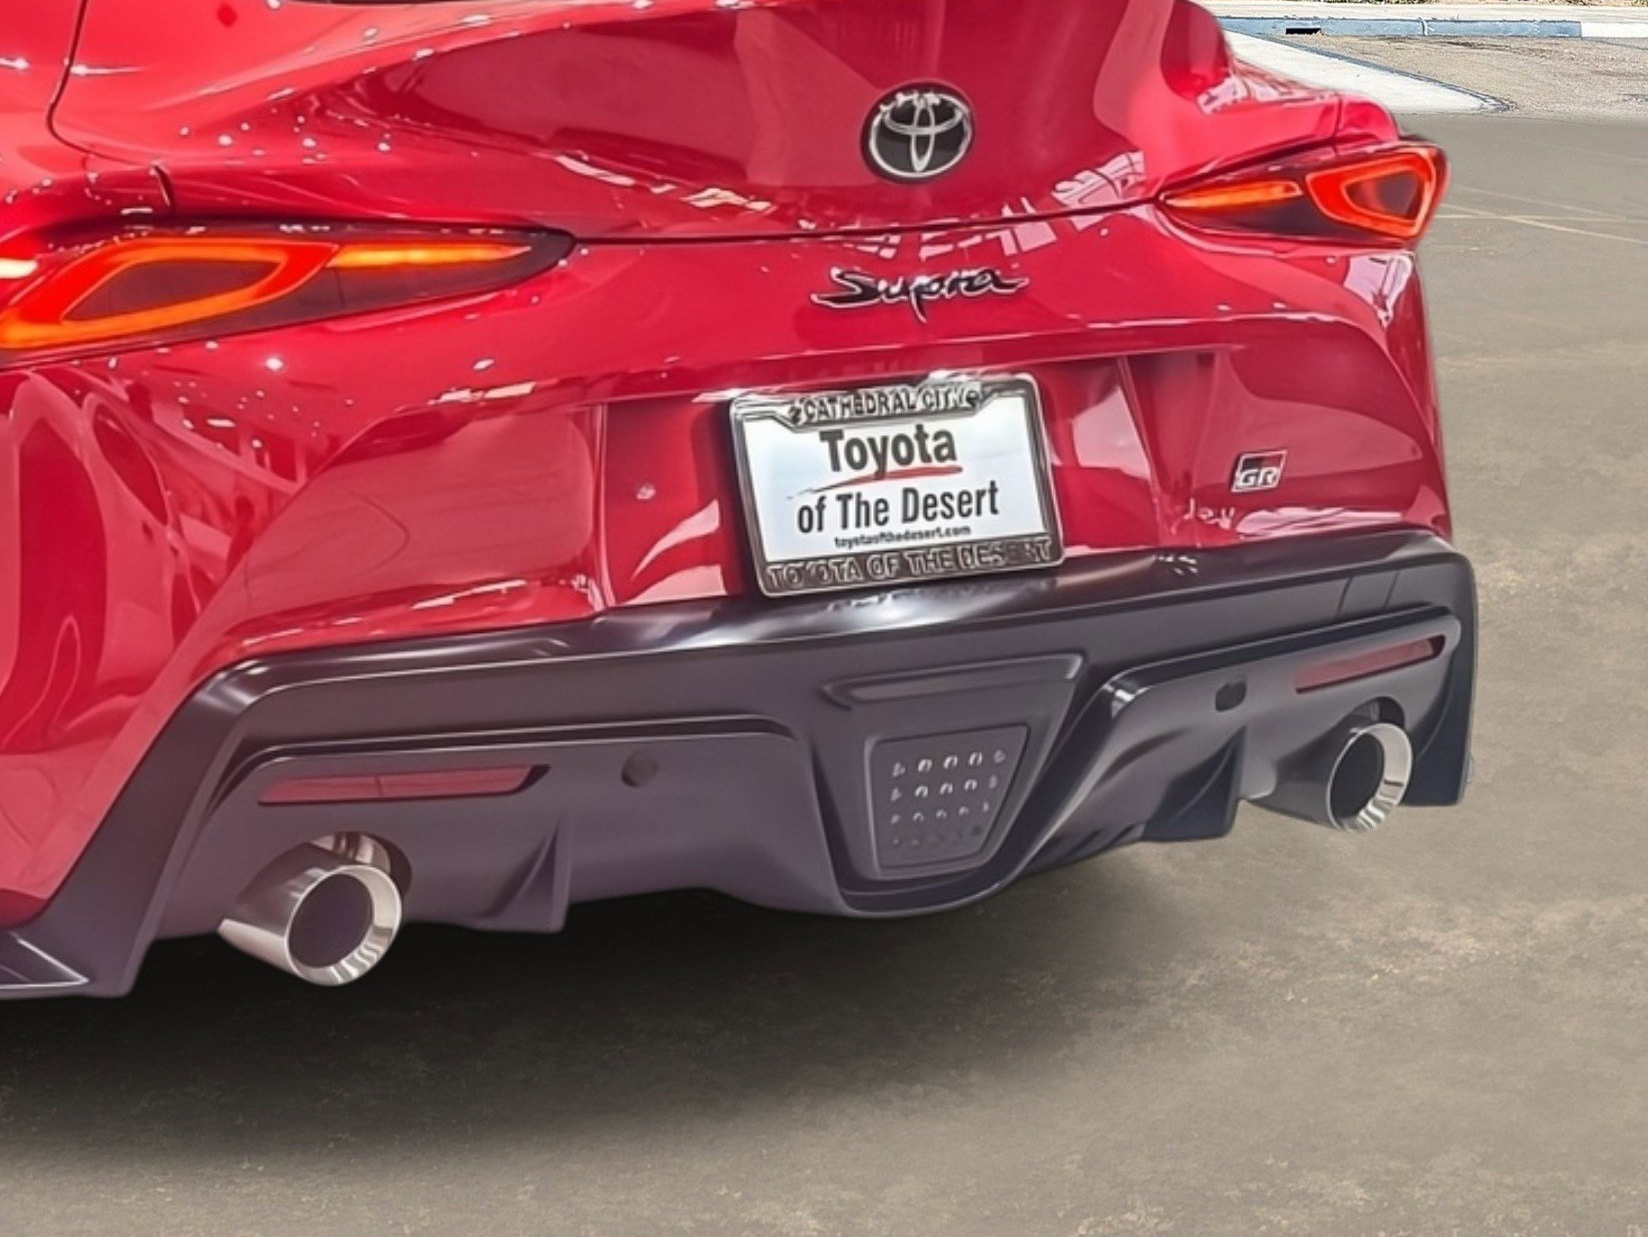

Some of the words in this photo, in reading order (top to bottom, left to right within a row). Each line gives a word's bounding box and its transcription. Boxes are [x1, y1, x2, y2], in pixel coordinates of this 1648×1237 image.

[810, 267, 1029, 324] Supra
[820, 424, 958, 480] Toyota
[797, 496, 826, 534] of
[836, 493, 890, 530] The
[902, 480, 1000, 524] Desert
[866, 552, 900, 580] OF
[903, 548, 954, 575] THE
[956, 536, 1052, 570] DEST
